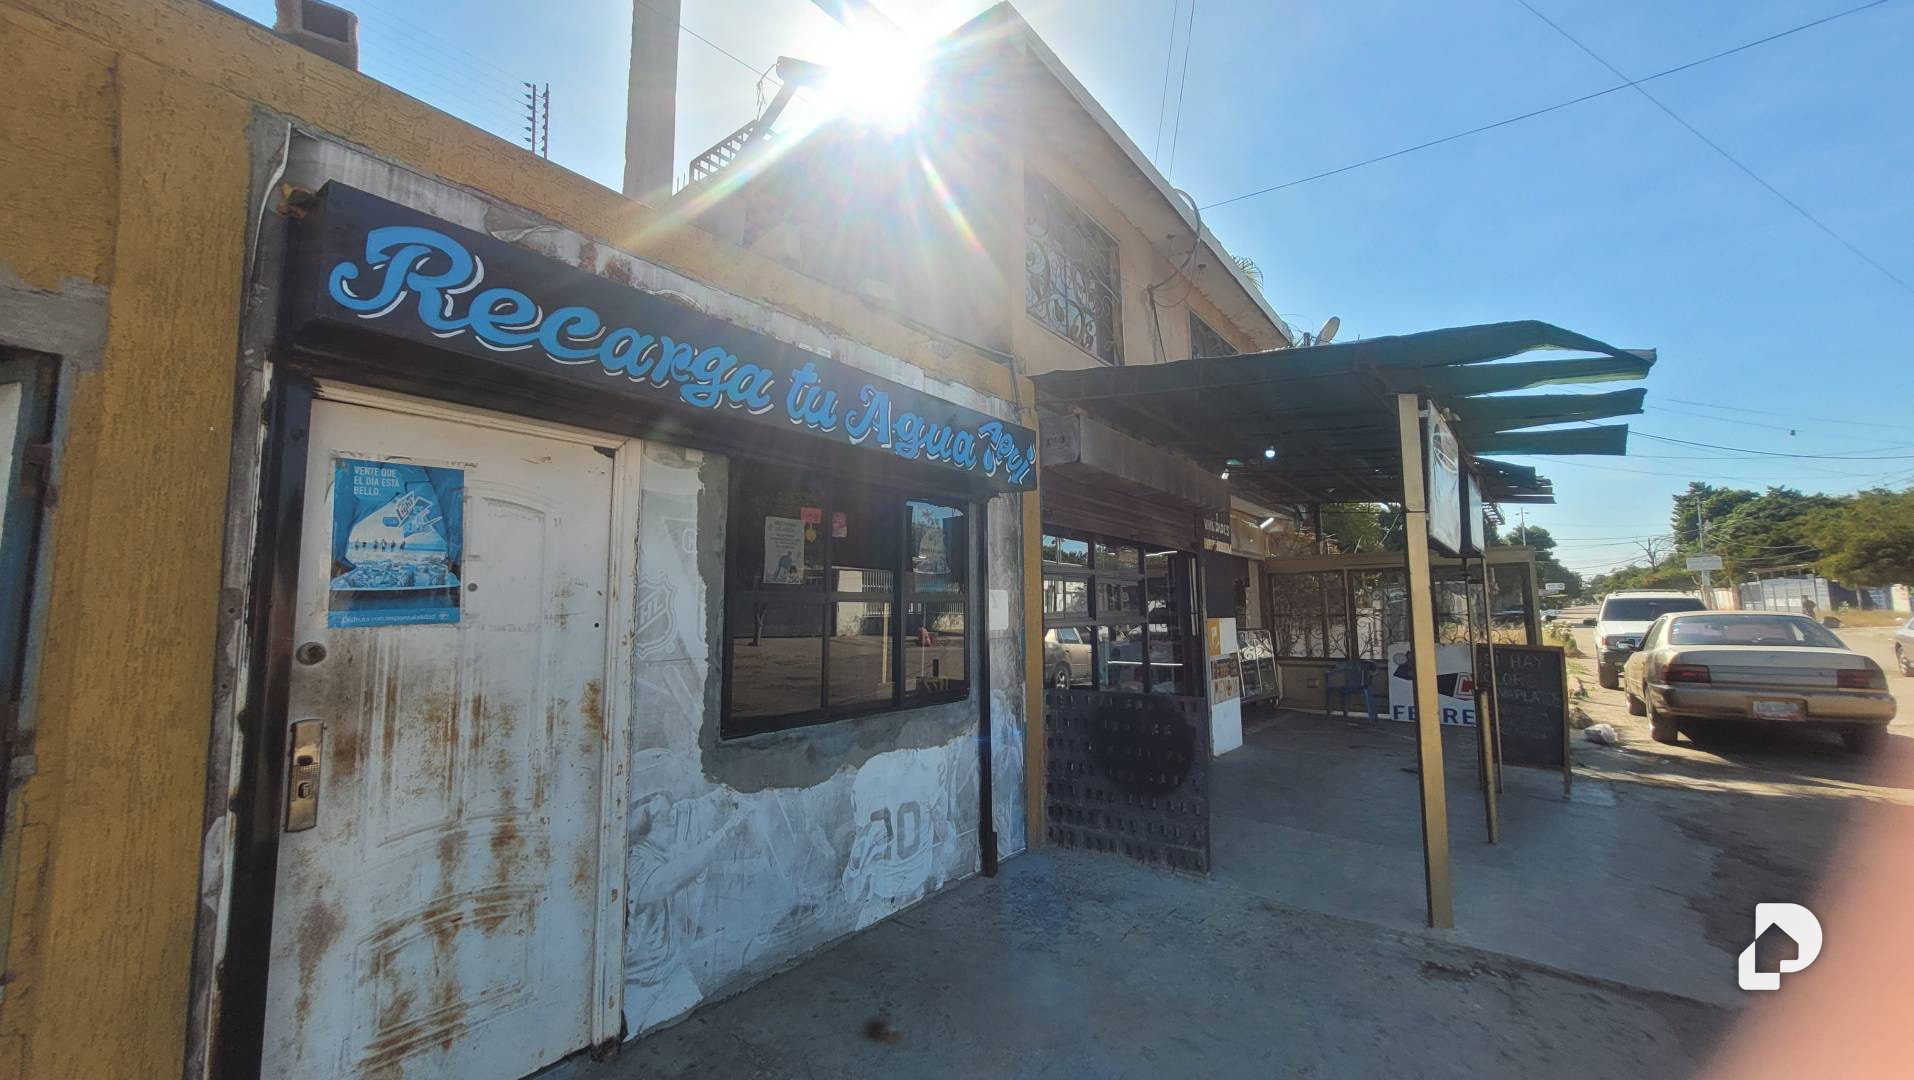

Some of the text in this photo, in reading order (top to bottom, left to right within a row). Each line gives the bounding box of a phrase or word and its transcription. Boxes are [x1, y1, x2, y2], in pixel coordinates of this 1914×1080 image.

[328, 225, 775, 415] Recarga
[787, 361, 838, 433] tu
[845, 384, 977, 477] Agua
[354, 466, 397, 478] VENTE QUE
[353, 476, 365, 485] EL
[1510, 655, 1545, 669] HAY
